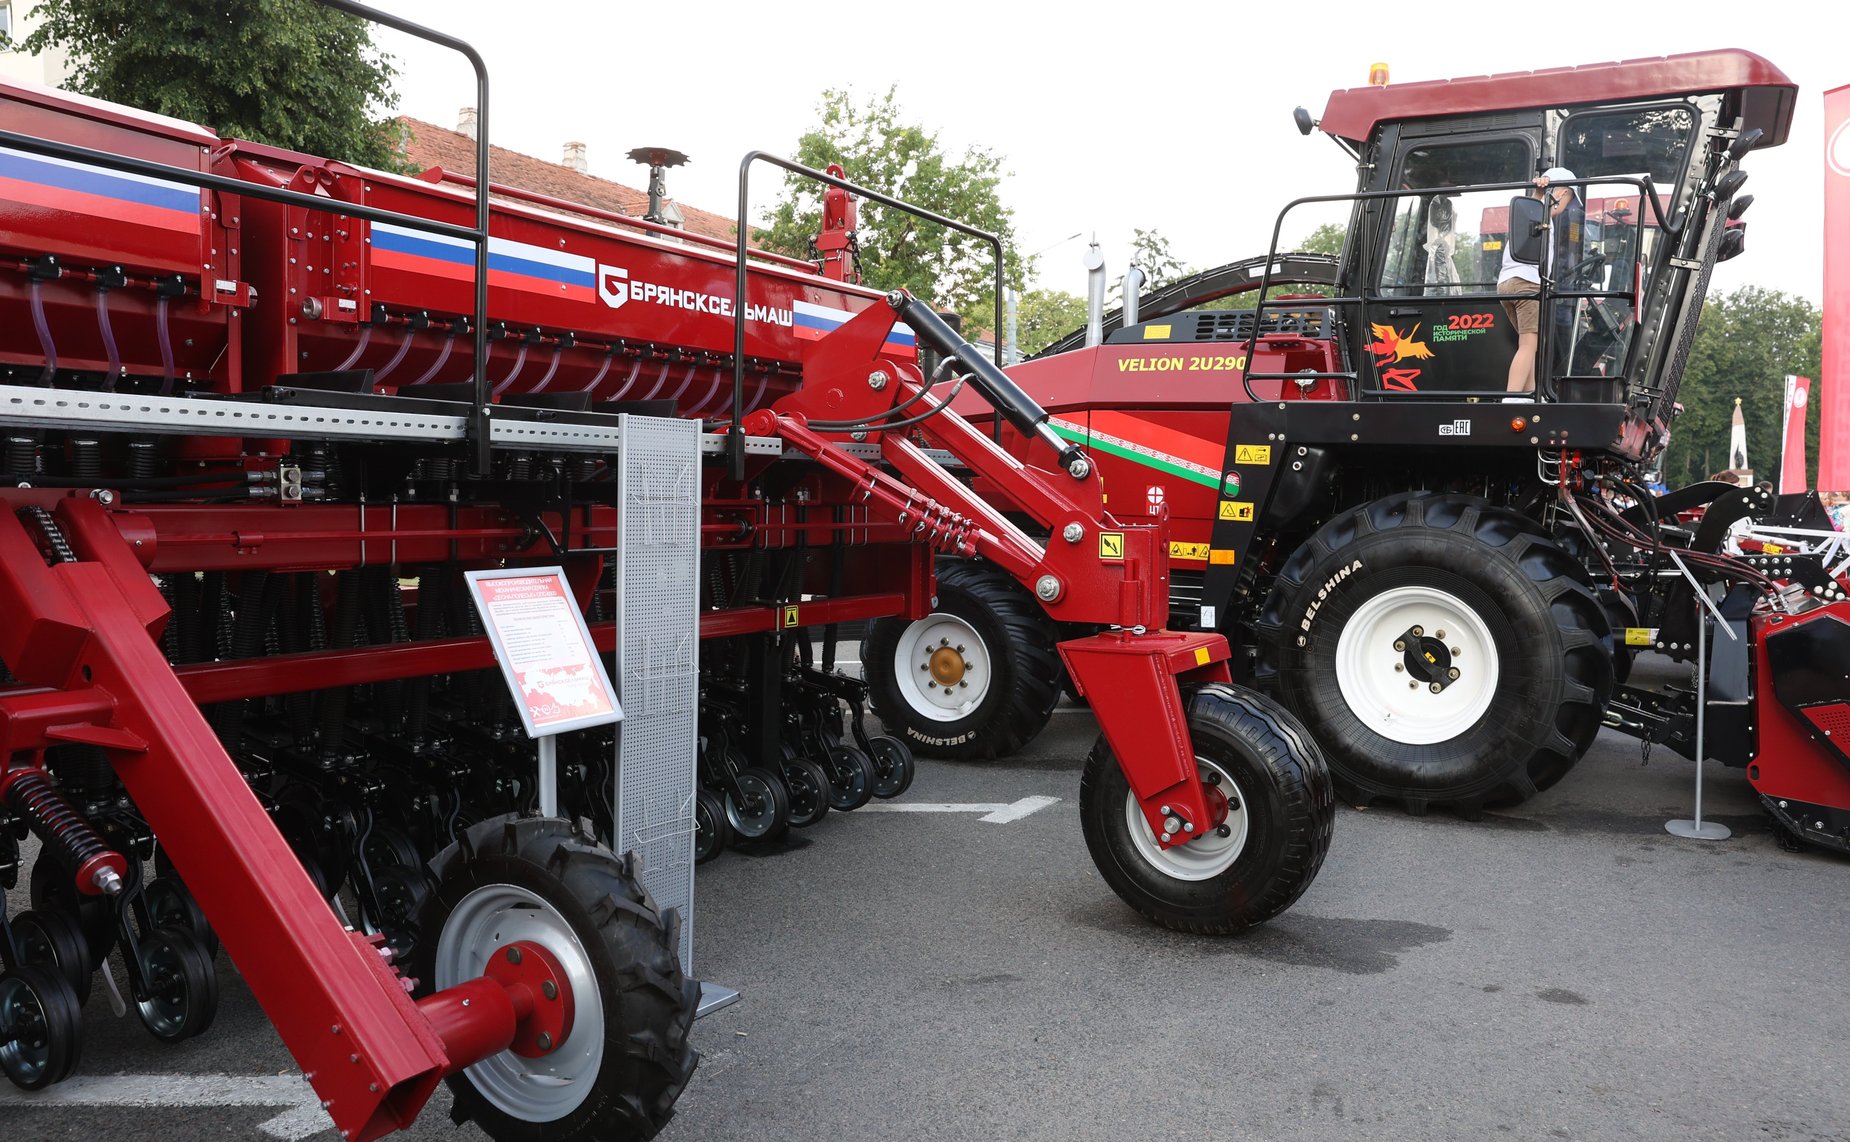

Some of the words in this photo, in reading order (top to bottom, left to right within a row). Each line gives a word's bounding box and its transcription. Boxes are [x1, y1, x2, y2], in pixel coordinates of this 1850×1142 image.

[630, 280, 792, 327] БРЯНСКСЕЬМАШ
[1448, 313, 1494, 329] 2022
[1433, 328, 1486, 336] ИСТОРИЧЕСКОЙ
[1433, 334, 1468, 342] ПАМЯТИ
[1118, 358, 1184, 372] VELION
[1301, 559, 1363, 632] BELSHINA
[906, 726, 967, 746] BELSHINA
